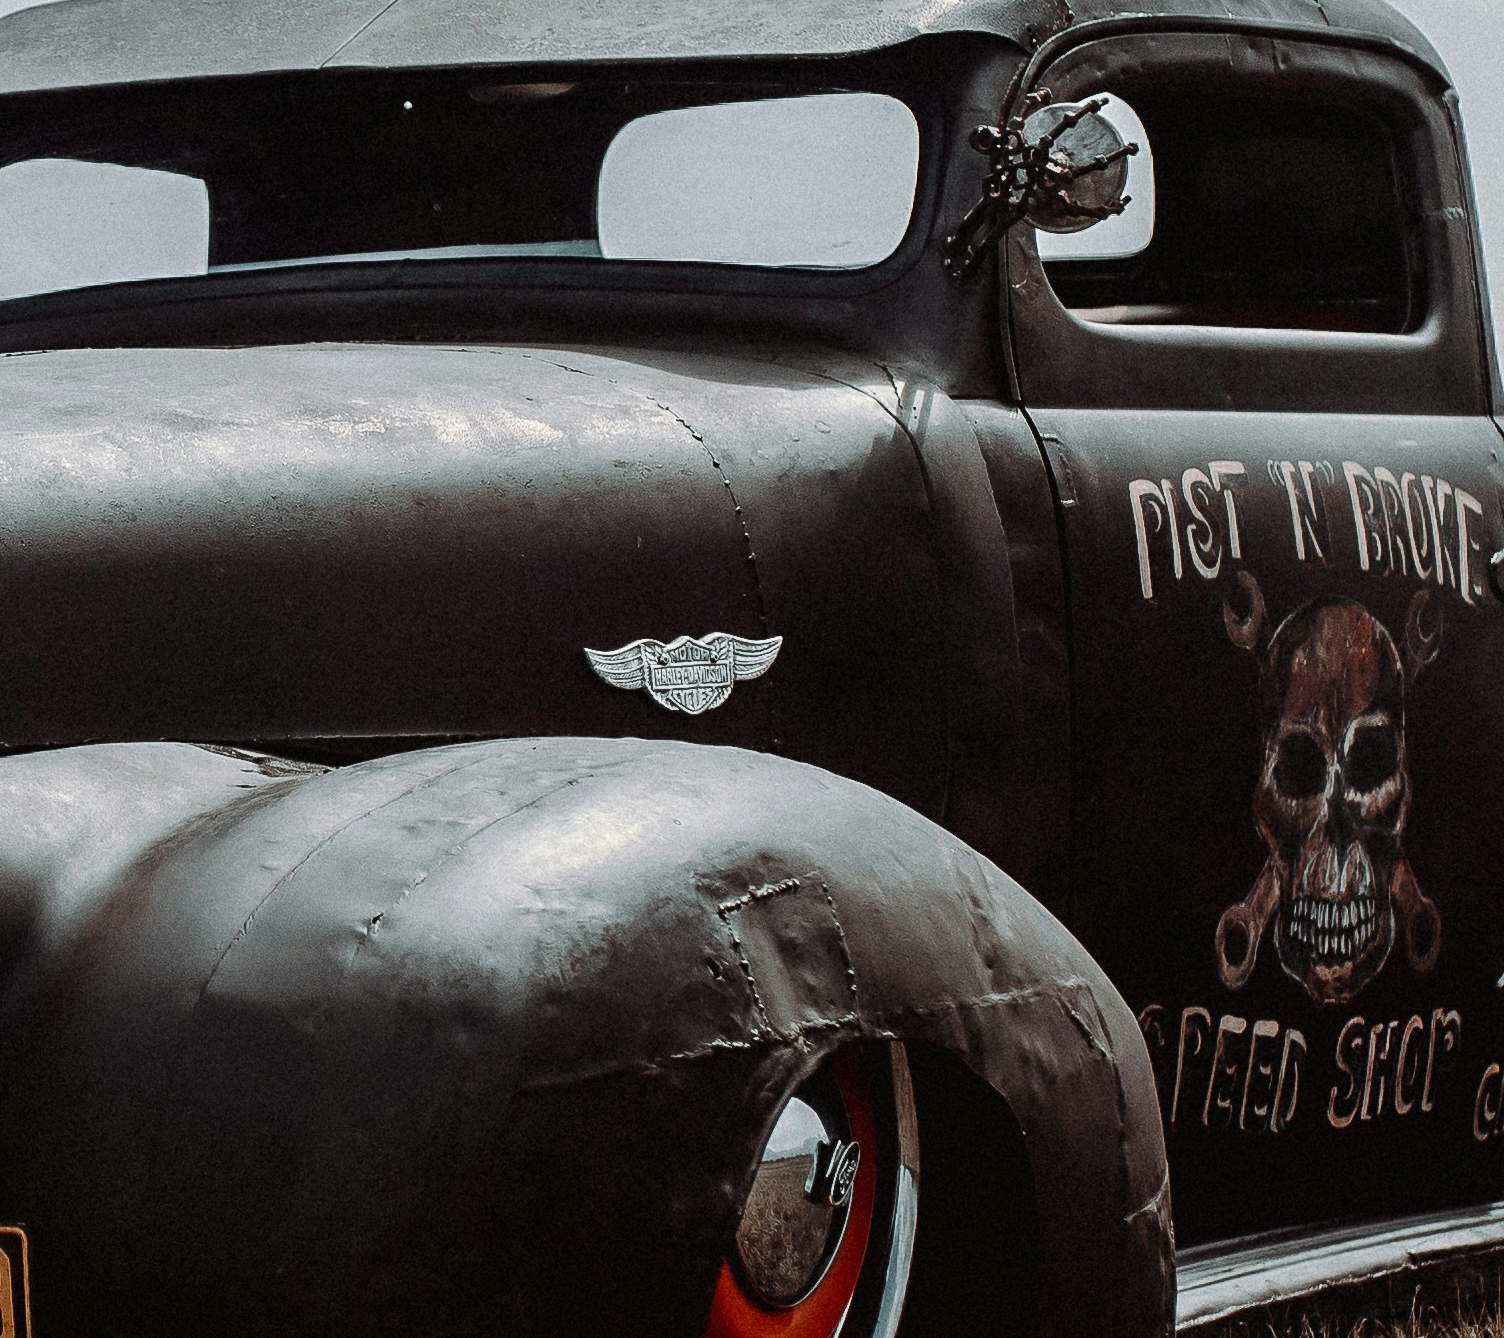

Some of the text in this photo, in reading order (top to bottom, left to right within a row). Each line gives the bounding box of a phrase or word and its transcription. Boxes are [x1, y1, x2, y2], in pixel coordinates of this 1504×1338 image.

[1128, 460, 1246, 601] PIST
[1342, 460, 1484, 605] BROKE
[1327, 1007, 1462, 1128] SHOP
